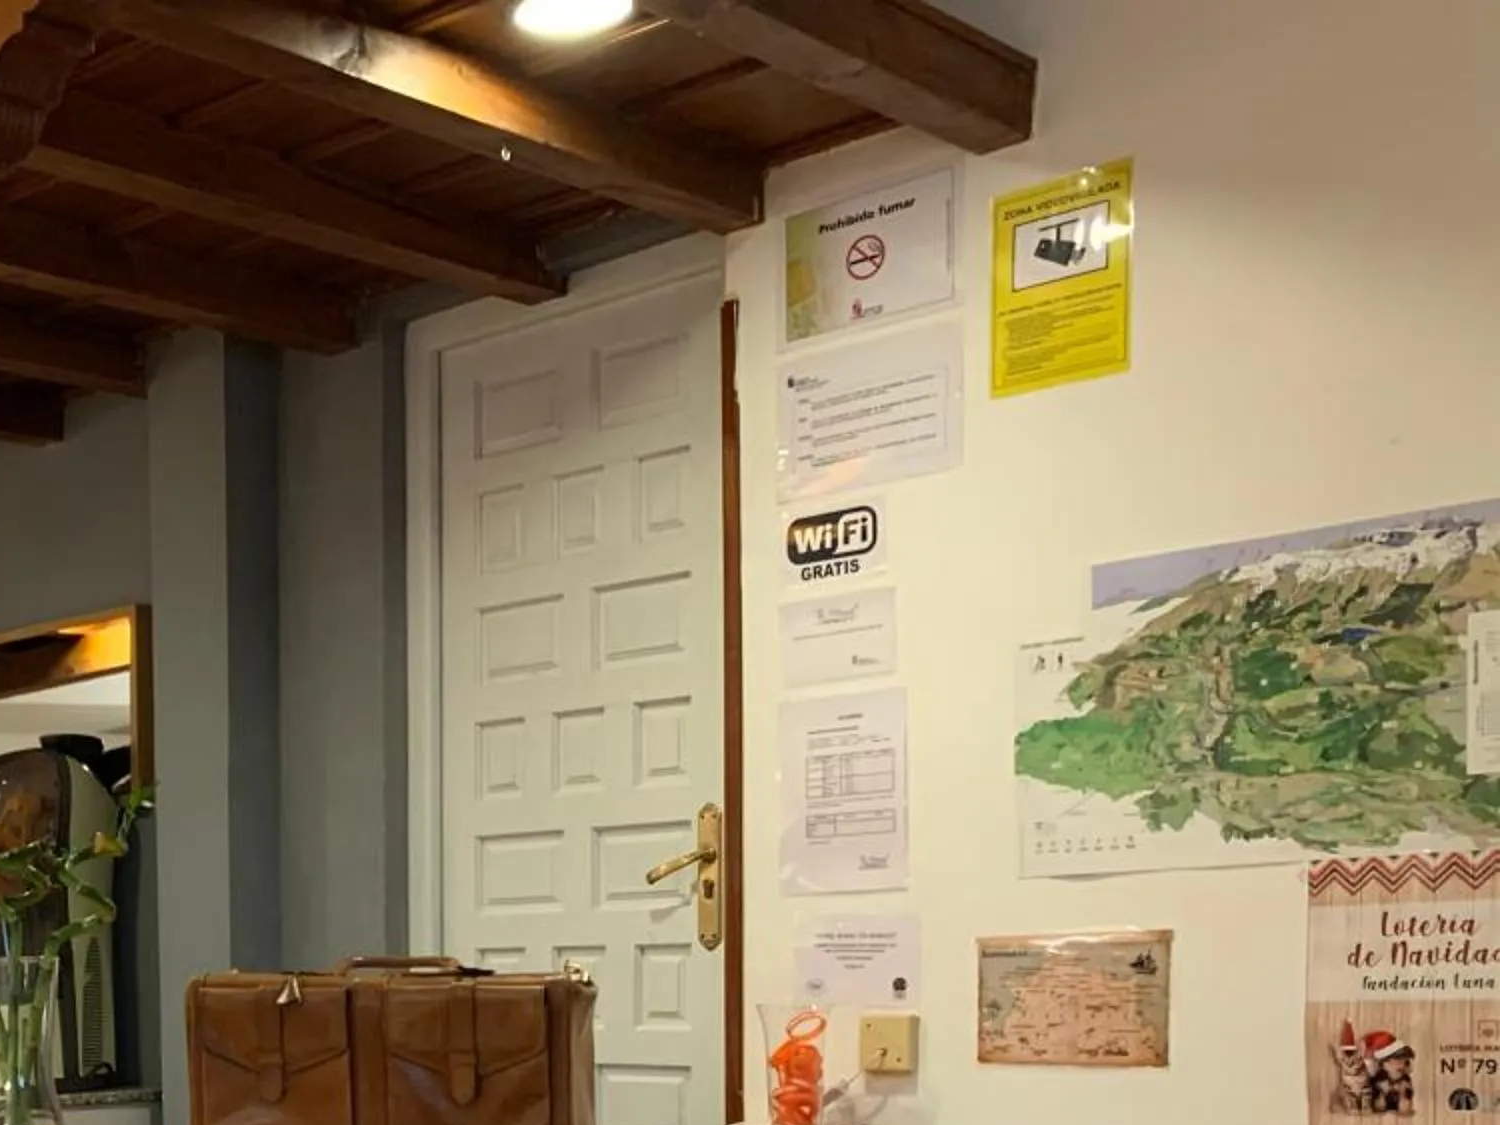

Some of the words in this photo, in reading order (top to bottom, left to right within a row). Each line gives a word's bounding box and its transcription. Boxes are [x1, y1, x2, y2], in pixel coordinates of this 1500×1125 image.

[818, 208, 875, 235] Prohibido
[878, 197, 916, 217] fumar
[801, 558, 861, 581] GRATIS
[1347, 942, 1378, 968] de
